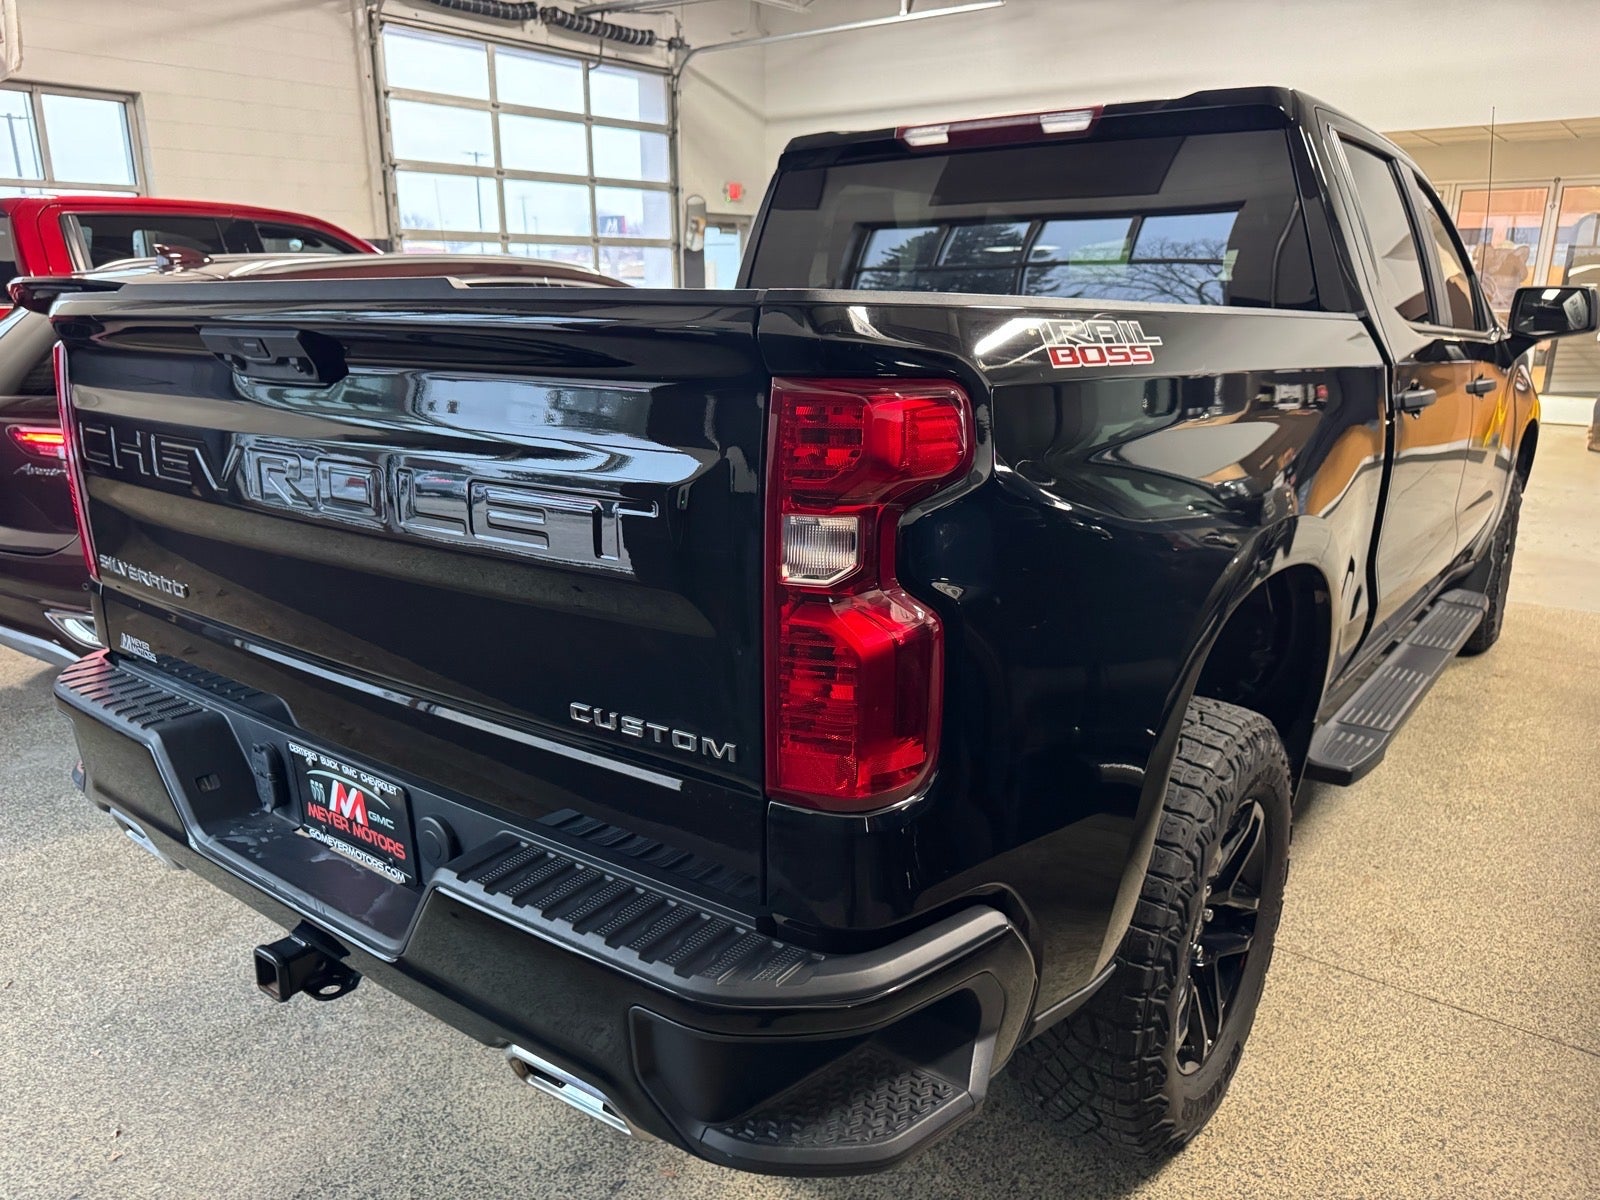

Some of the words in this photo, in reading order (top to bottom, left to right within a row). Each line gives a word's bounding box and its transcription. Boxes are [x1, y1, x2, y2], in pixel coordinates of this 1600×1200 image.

[1038, 320, 1163, 346] TRAIL
[1046, 344, 1155, 369] BOSS
[79, 421, 658, 561] CHEVROLET
[99, 553, 190, 598] SILVERADO
[130, 636, 150, 651] MEYER
[569, 701, 737, 763] CUSTOM
[288, 743, 317, 761] CERTIFIED
[320, 756, 340, 771] BUICK
[341, 765, 358, 779] GMC
[360, 773, 397, 796] CHEVROLET
[308, 801, 350, 833] MEYER
[353, 822, 407, 860] MOTORS
[368, 811, 395, 830] GMC
[308, 828, 406, 884] GOMEYERMOTORS.COM
